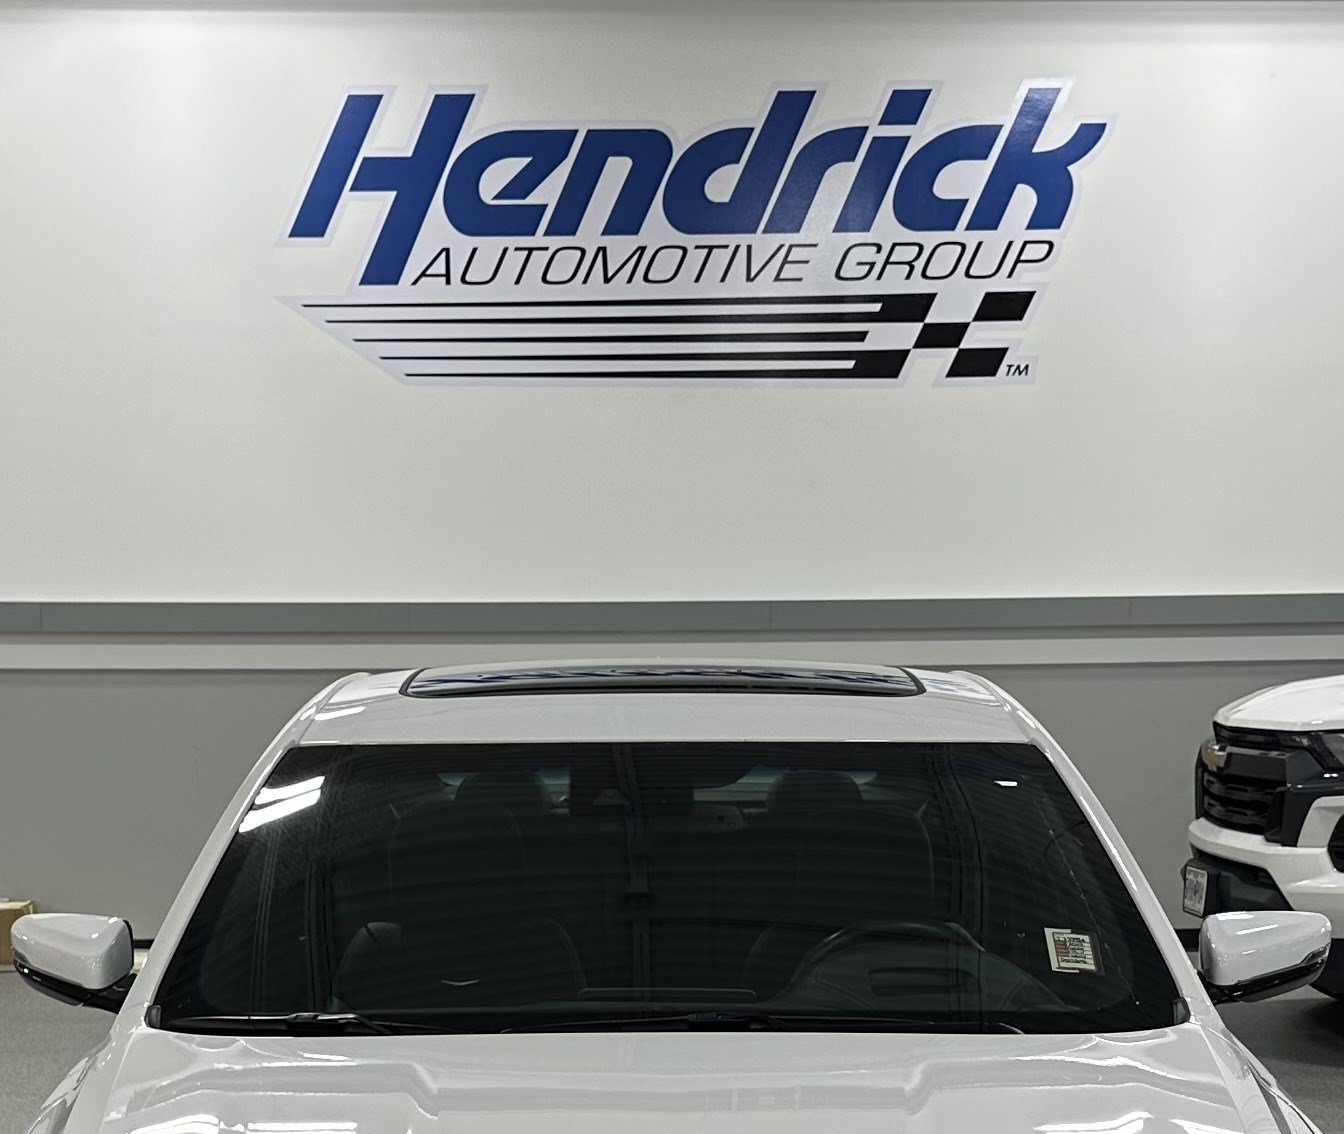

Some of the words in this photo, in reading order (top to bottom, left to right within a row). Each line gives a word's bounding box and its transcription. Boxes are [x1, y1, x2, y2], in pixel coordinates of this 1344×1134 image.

[288, 88, 1107, 286] Hendrick
[411, 243, 818, 286] AUTOMOTIVE
[835, 239, 1056, 281] GROUP
[1006, 364, 1029, 376] TM
